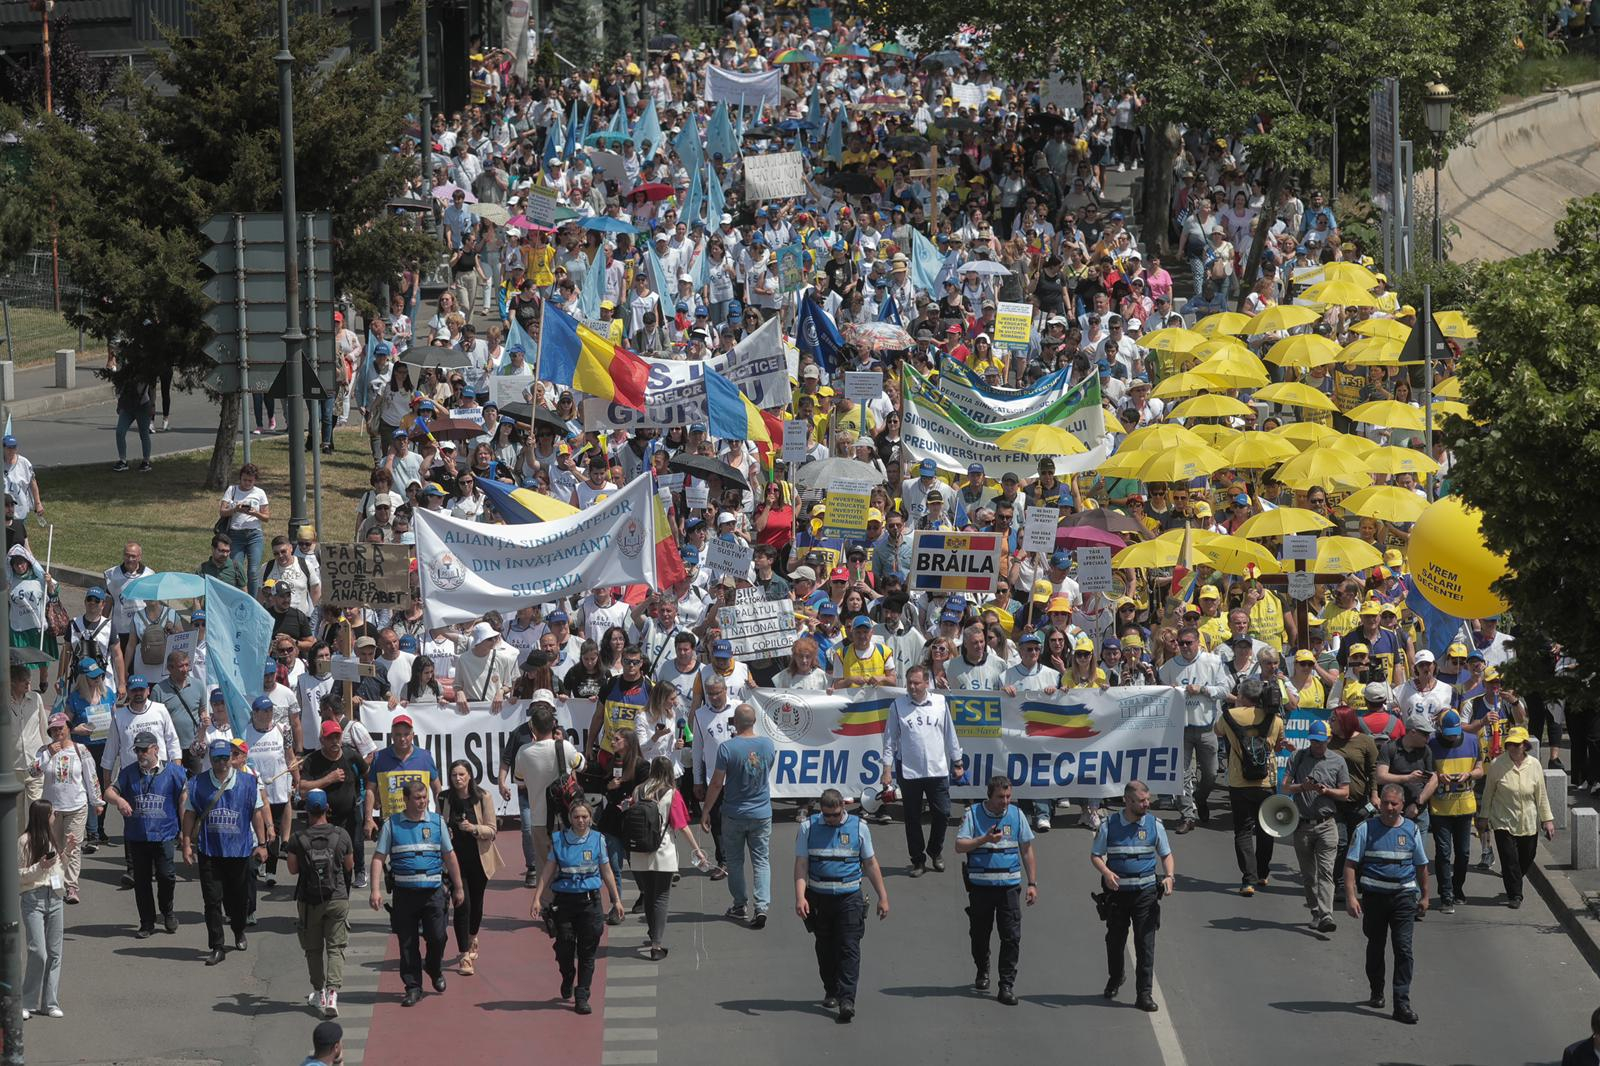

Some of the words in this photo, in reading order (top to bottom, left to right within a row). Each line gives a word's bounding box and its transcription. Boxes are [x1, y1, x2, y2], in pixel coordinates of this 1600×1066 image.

[520, 500, 632, 549] SINDICATELOR
[472, 558, 501, 573] DIN
[916, 549, 995, 574] BRĂILA
[1422, 568, 1462, 592] SALARII
[1428, 562, 1458, 582] VREM
[332, 580, 378, 592] POPOR
[511, 573, 583, 597] SUCEAVA
[1417, 574, 1464, 601] DECENTE!
[330, 589, 406, 604] ANALFABET
[735, 604, 777, 617] PALATUL
[752, 637, 793, 651] COPIILOR
[907, 715, 939, 730] FSLI
[775, 749, 850, 784] REM
[1007, 747, 1178, 787] DECENTE!
